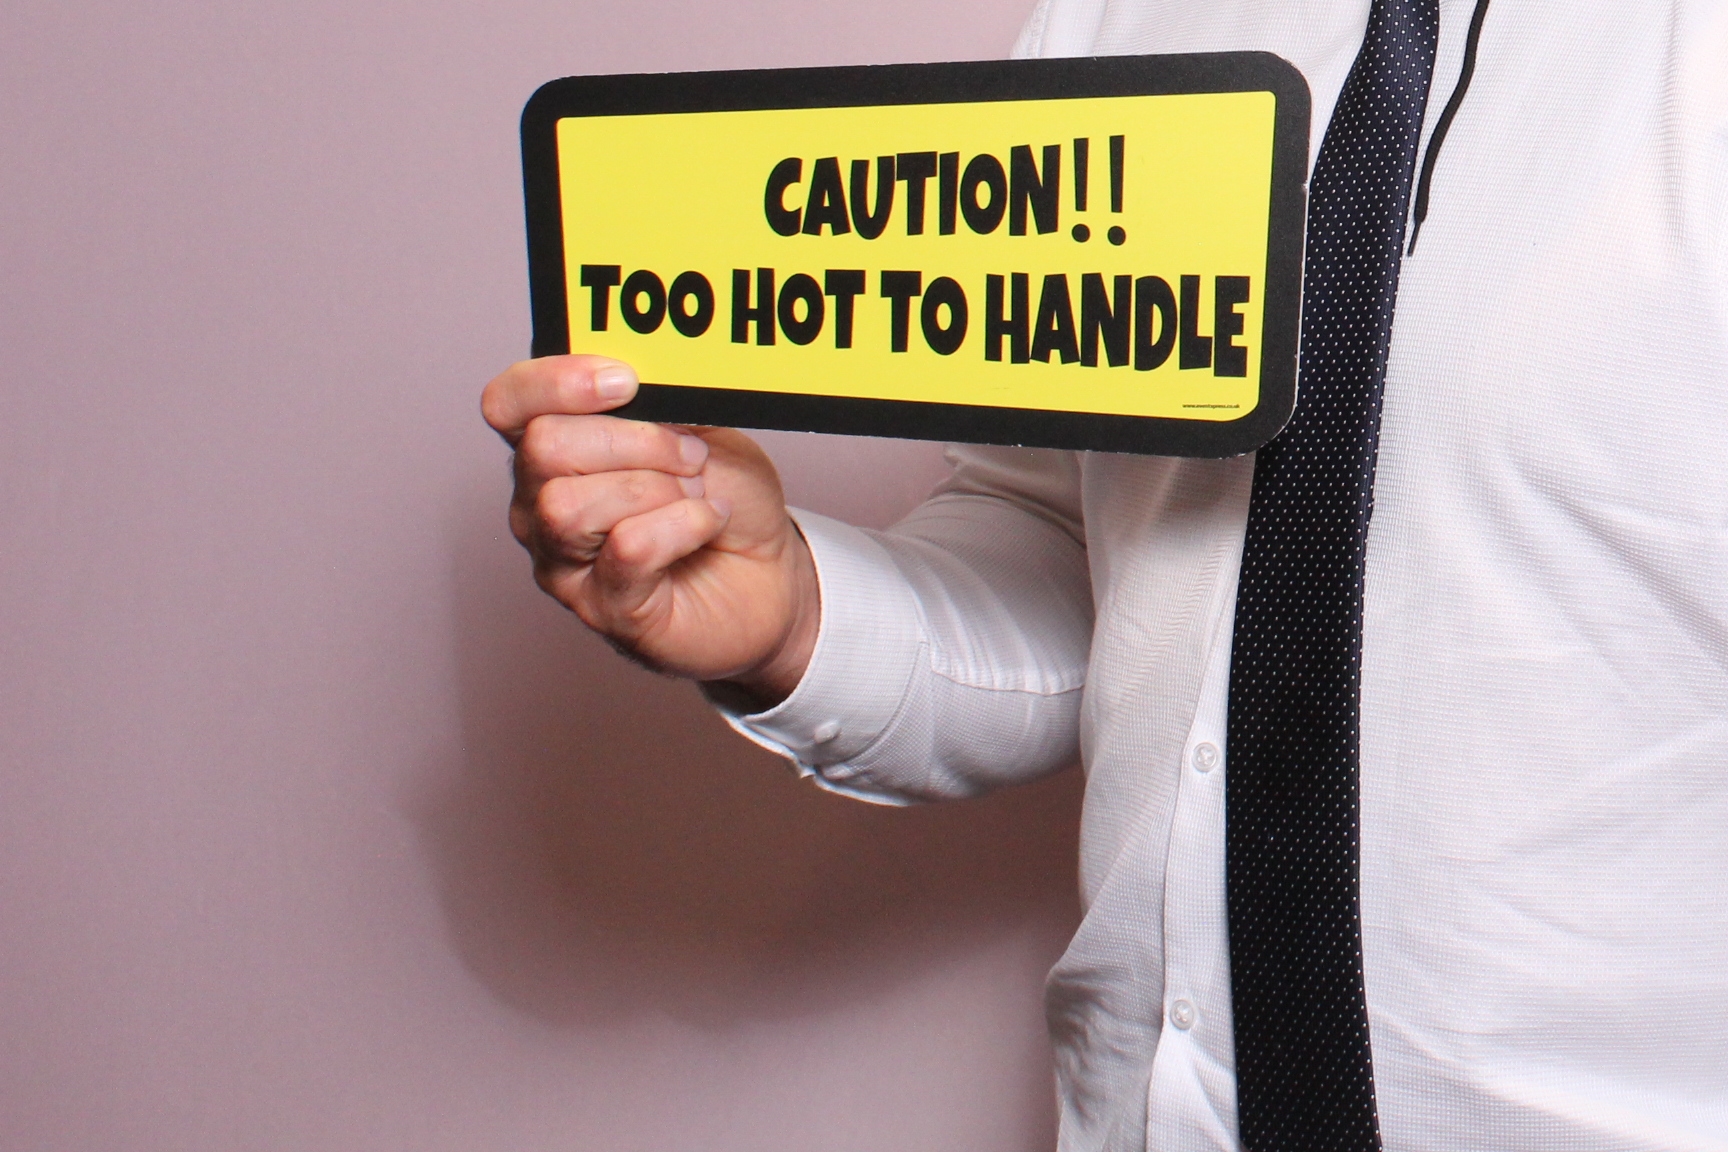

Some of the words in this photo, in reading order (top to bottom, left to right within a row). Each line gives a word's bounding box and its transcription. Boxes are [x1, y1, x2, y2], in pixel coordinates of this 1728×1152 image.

[764, 134, 1127, 246] CAUTION!!
[580, 264, 715, 338] TOO
[731, 267, 866, 349] HOT
[880, 270, 969, 356] TO
[984, 272, 1251, 378] HANDLE
